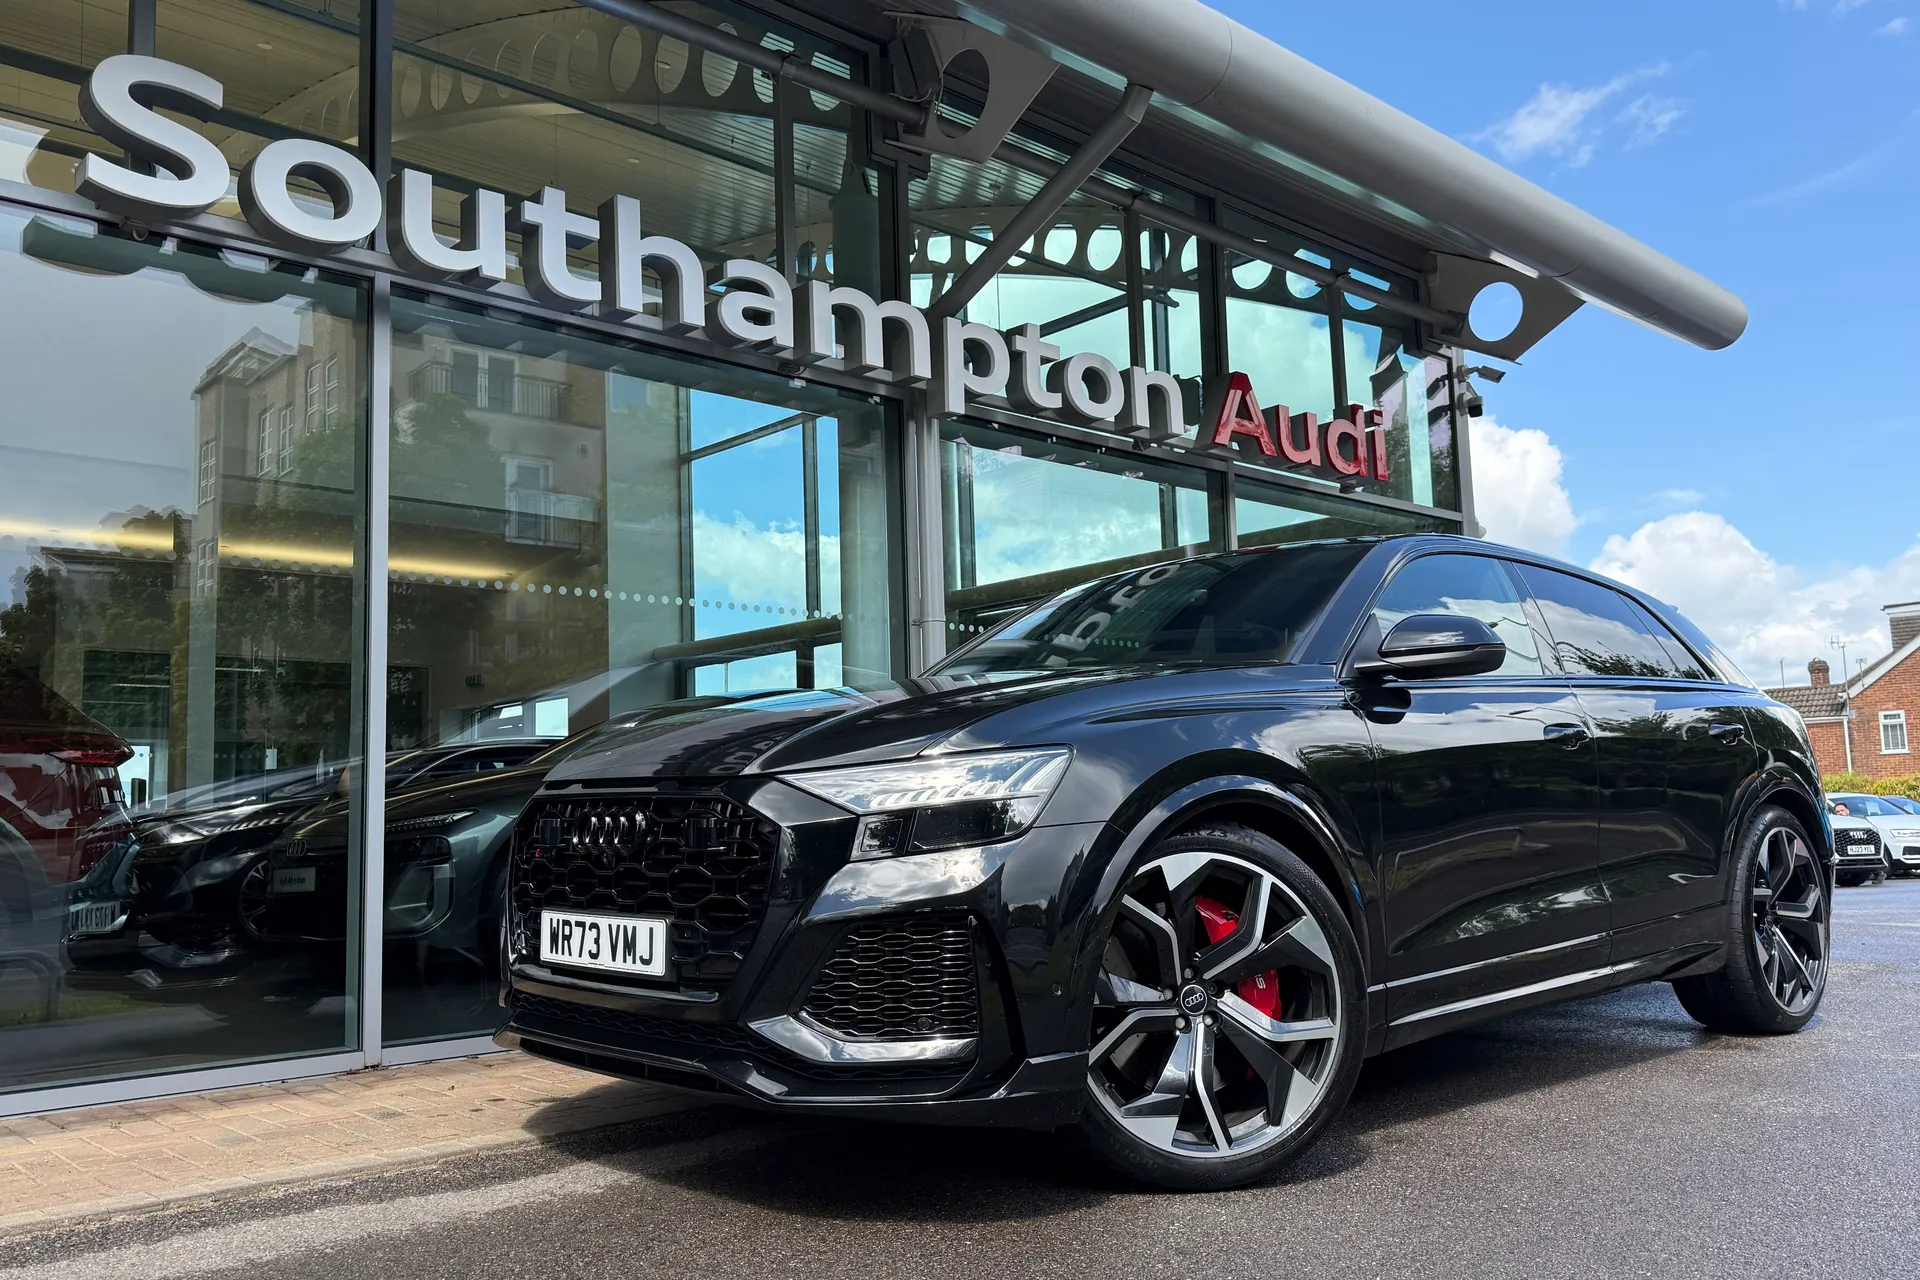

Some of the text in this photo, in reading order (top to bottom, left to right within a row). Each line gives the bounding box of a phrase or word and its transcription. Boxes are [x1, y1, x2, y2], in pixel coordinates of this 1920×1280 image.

[76, 54, 1389, 481] Southampton Audi
[549, 917, 654, 966] WR73 VMJ
[1254, 973, 1267, 989] S
